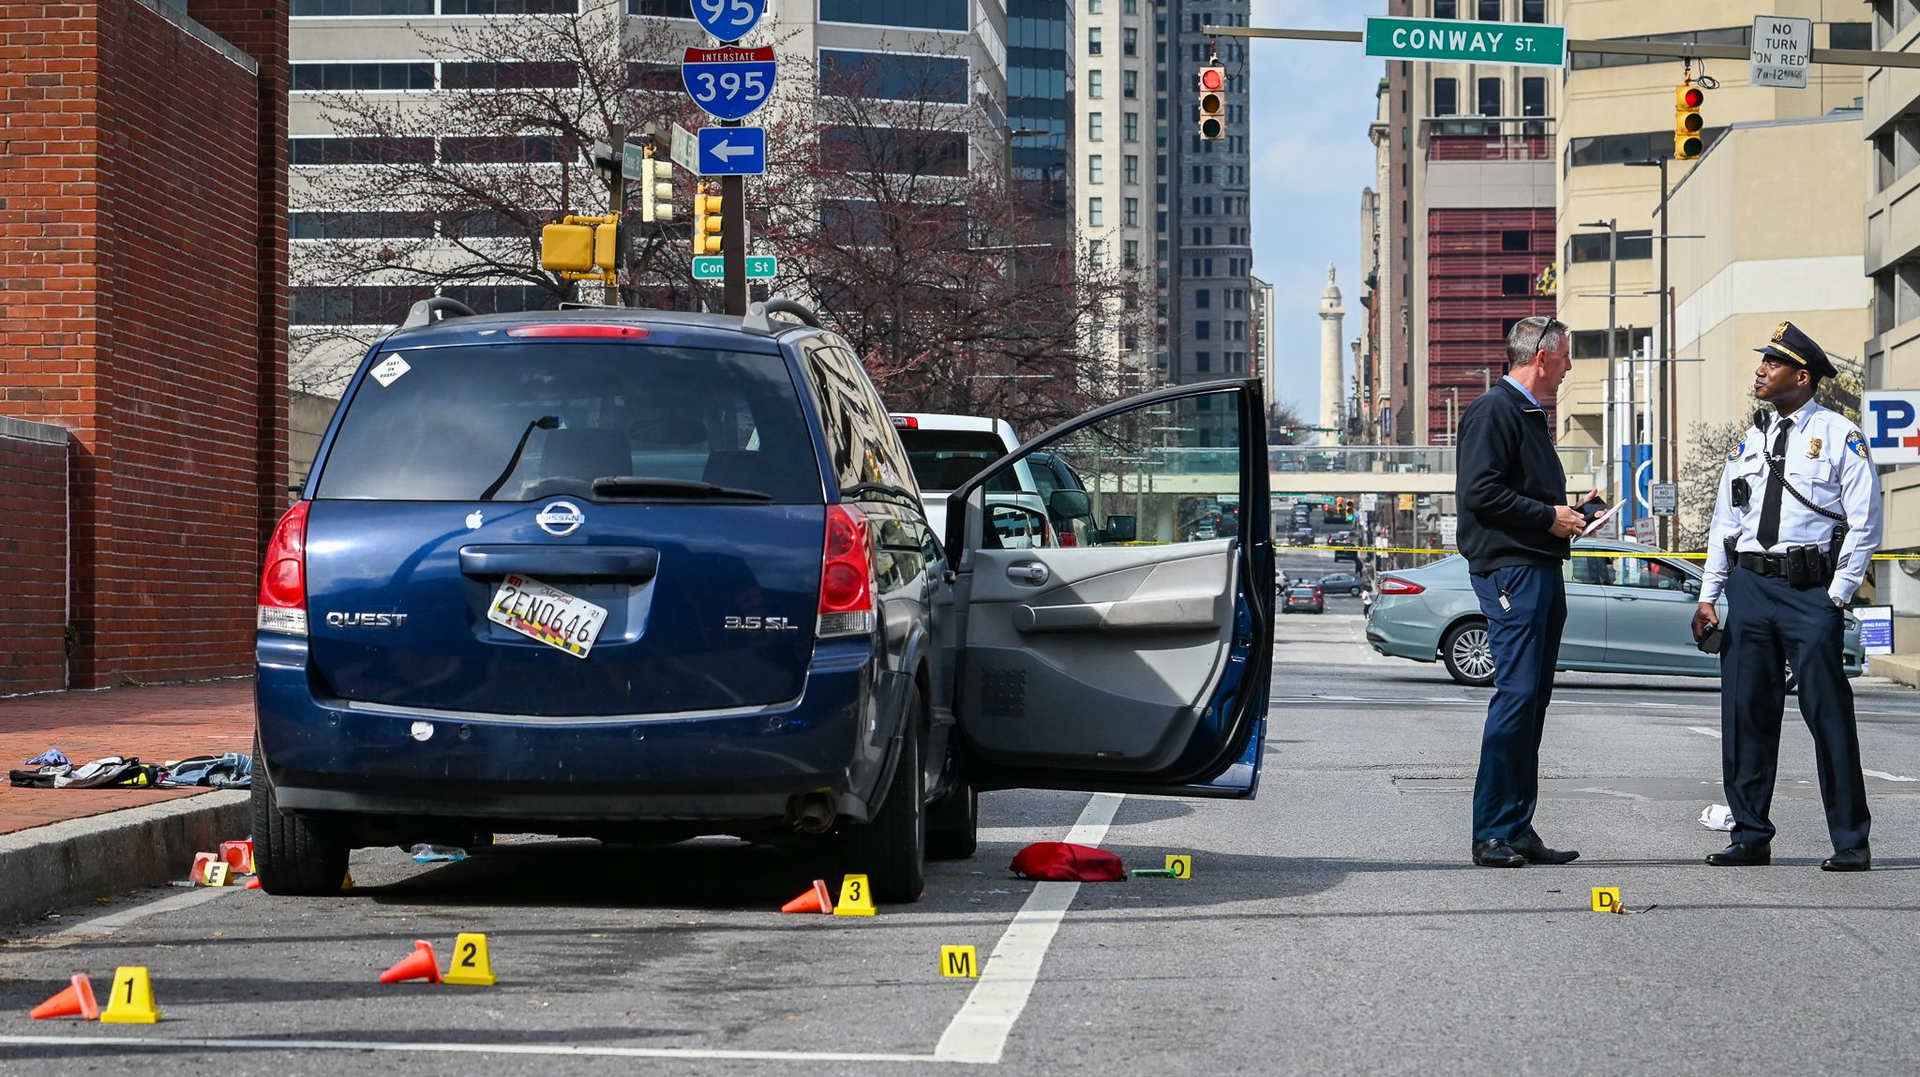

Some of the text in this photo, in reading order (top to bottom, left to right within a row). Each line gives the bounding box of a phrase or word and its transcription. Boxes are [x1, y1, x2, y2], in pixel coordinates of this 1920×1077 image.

[701, 0, 754, 25] 95
[1772, 23, 1792, 35] NO
[1392, 28, 1536, 53] CONWAY ST.
[1766, 38, 1797, 50] TURN
[702, 52, 755, 62] INTERSTATE
[1756, 52, 1804, 66] ON RED
[696, 72, 765, 101] 395
[754, 261, 769, 272] St
[1869, 400, 1915, 448] P
[326, 611, 408, 628] QUEST
[498, 586, 592, 642] 2EN0646
[724, 615, 799, 630] 3.5 SL
[209, 865, 221, 883] E
[849, 881, 861, 902] 3
[1599, 892, 1614, 908] D
[461, 942, 477, 968] 2
[948, 951, 971, 975] M
[124, 977, 134, 1004] 1
